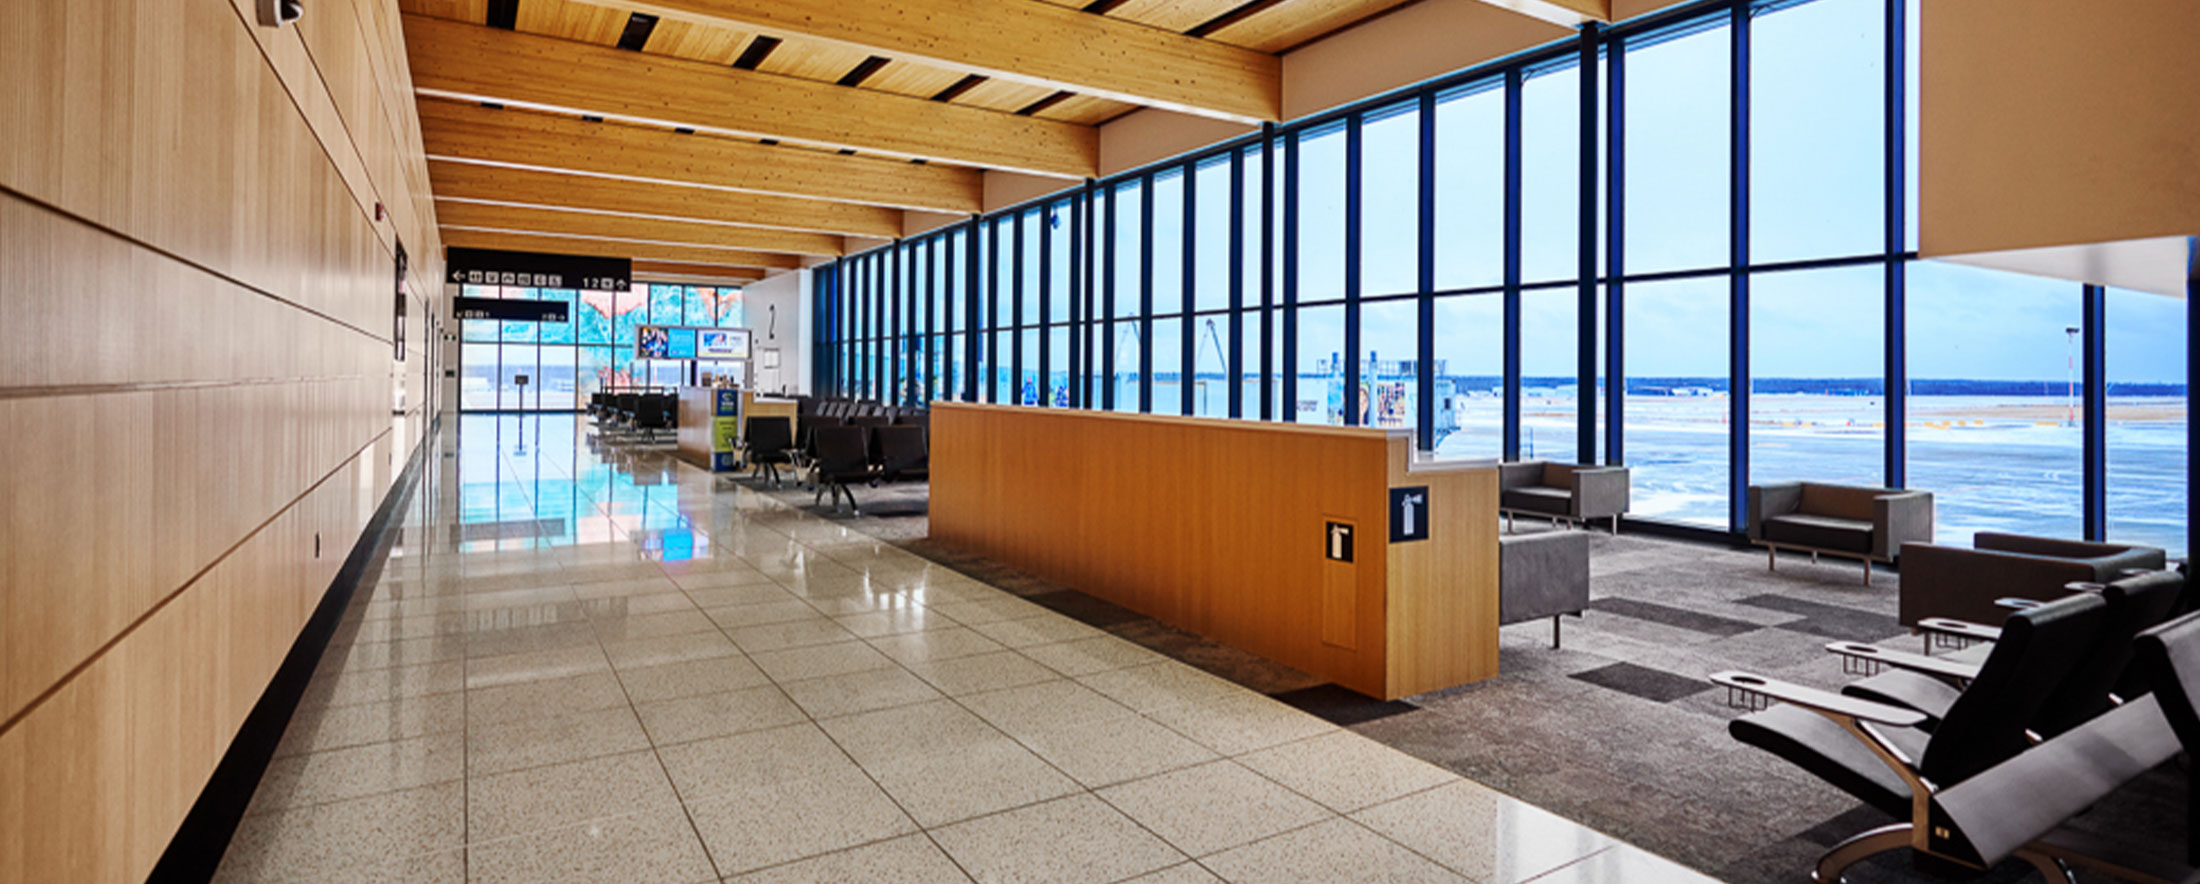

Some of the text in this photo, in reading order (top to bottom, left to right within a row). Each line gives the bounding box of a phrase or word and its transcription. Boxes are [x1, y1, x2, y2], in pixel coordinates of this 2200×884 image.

[583, 278, 599, 288] 1 2
[769, 304, 775, 340] 2
